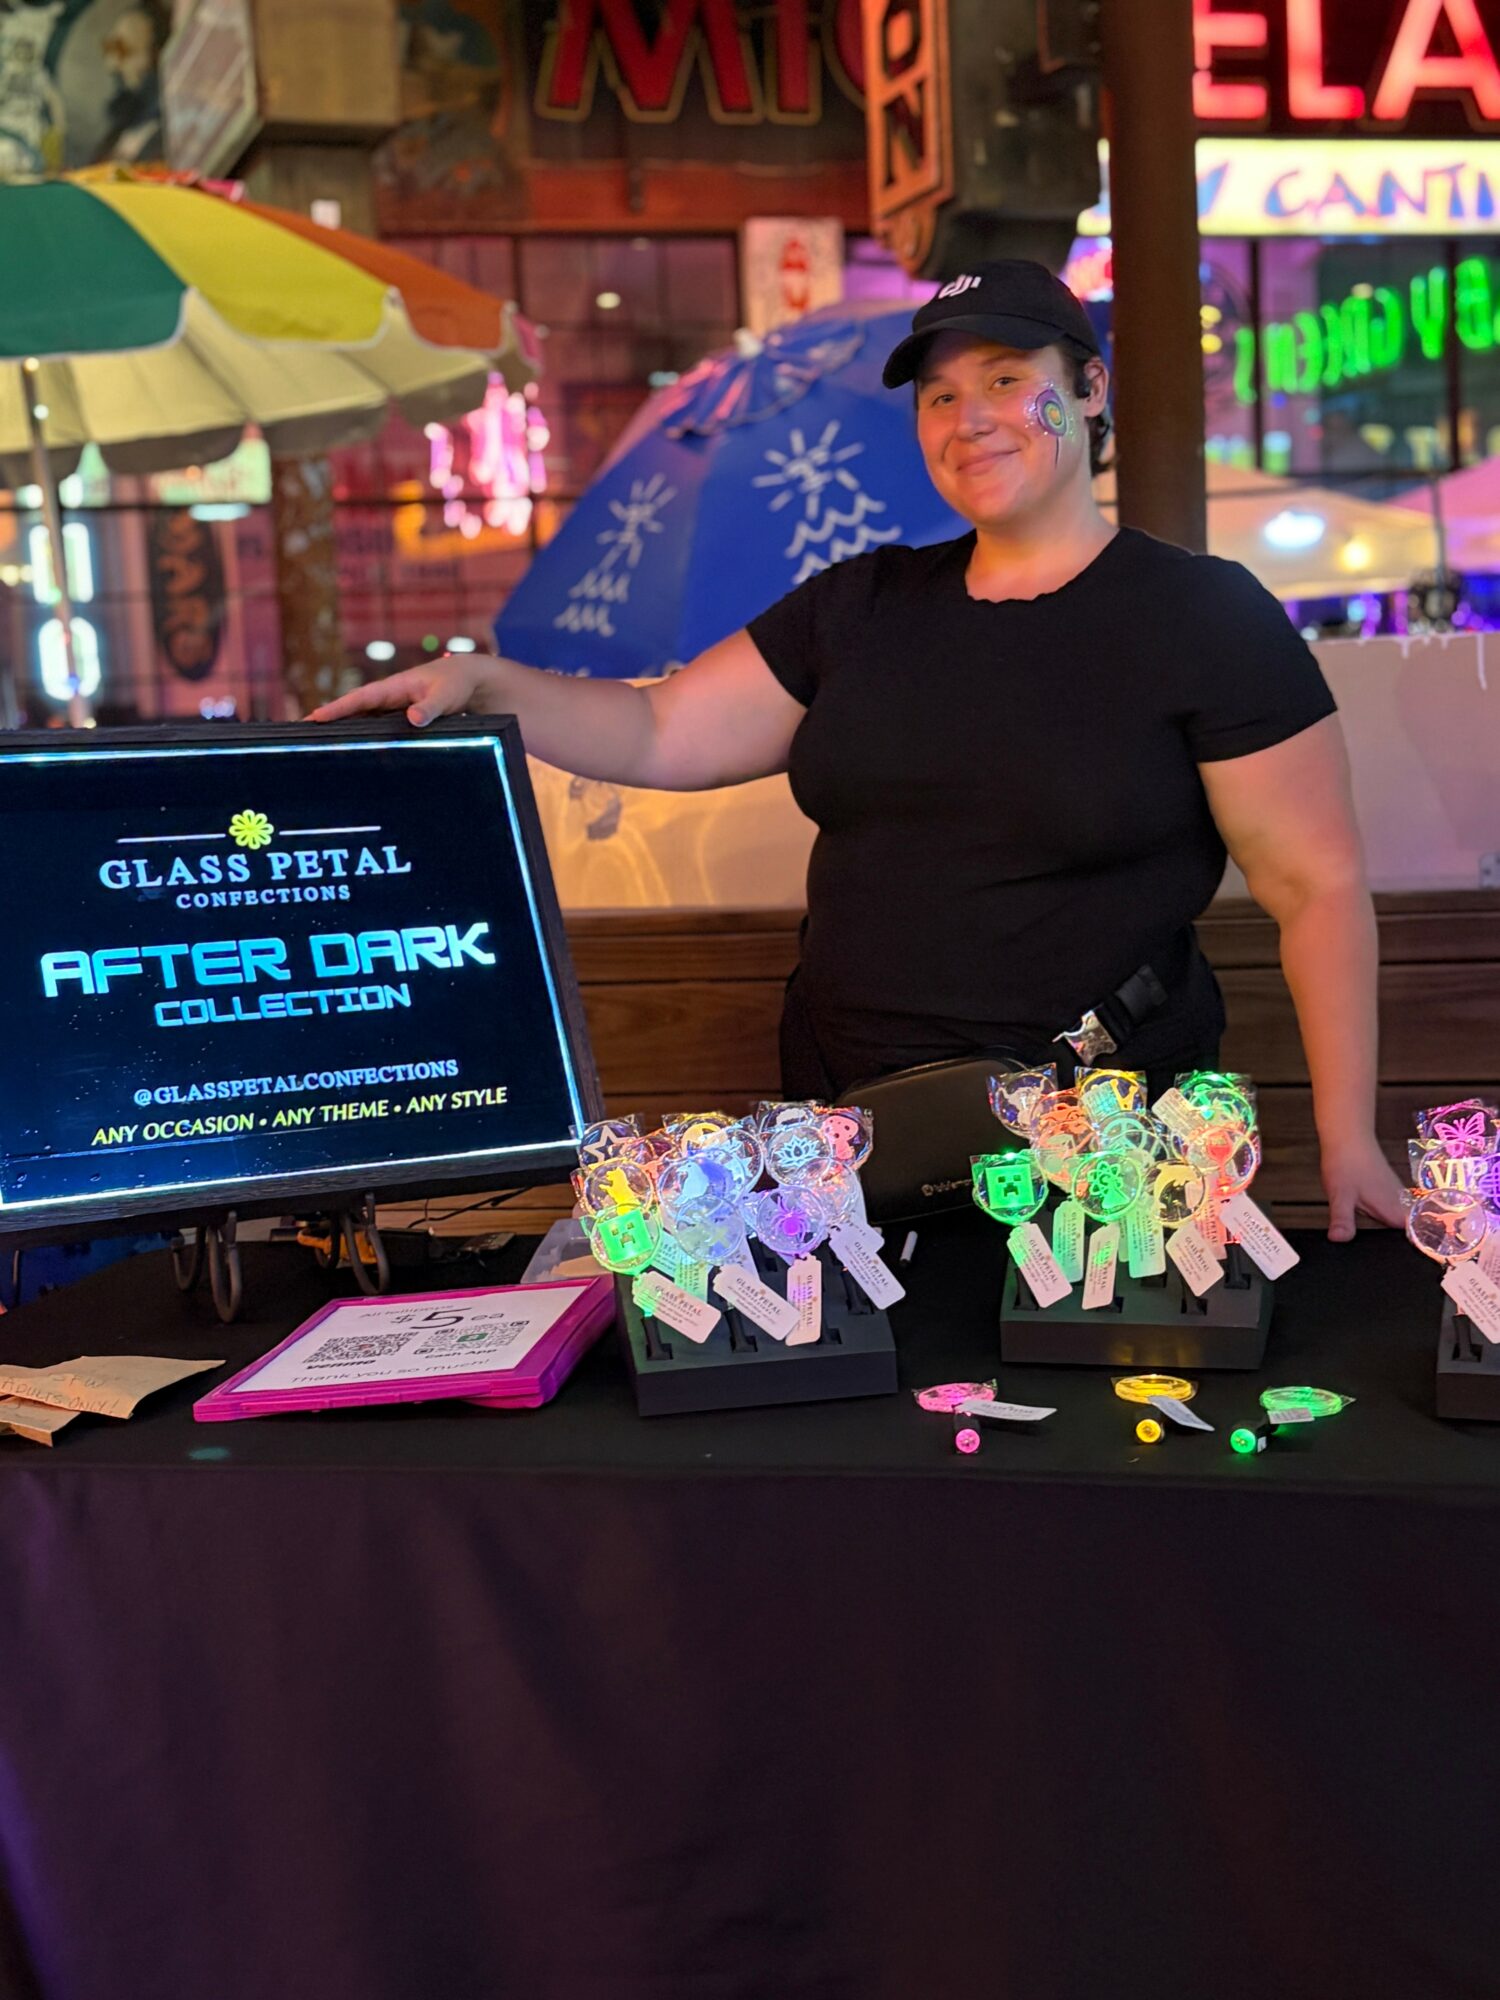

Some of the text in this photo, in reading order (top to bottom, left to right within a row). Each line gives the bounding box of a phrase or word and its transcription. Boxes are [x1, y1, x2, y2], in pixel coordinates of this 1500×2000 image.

[99, 846, 412, 889] GLASS PETAL
[176, 885, 351, 909] CONFECTIONS
[40, 922, 496, 998] AFTER DARK
[154, 983, 412, 1027] COLLECTION
[134, 1059, 459, 1106] @GLASSPETALCONFECTIONS
[91, 1087, 508, 1146] ANY OCCASION ANY THEME ANY STYLE
[1426, 1158, 1488, 1193] VIP
